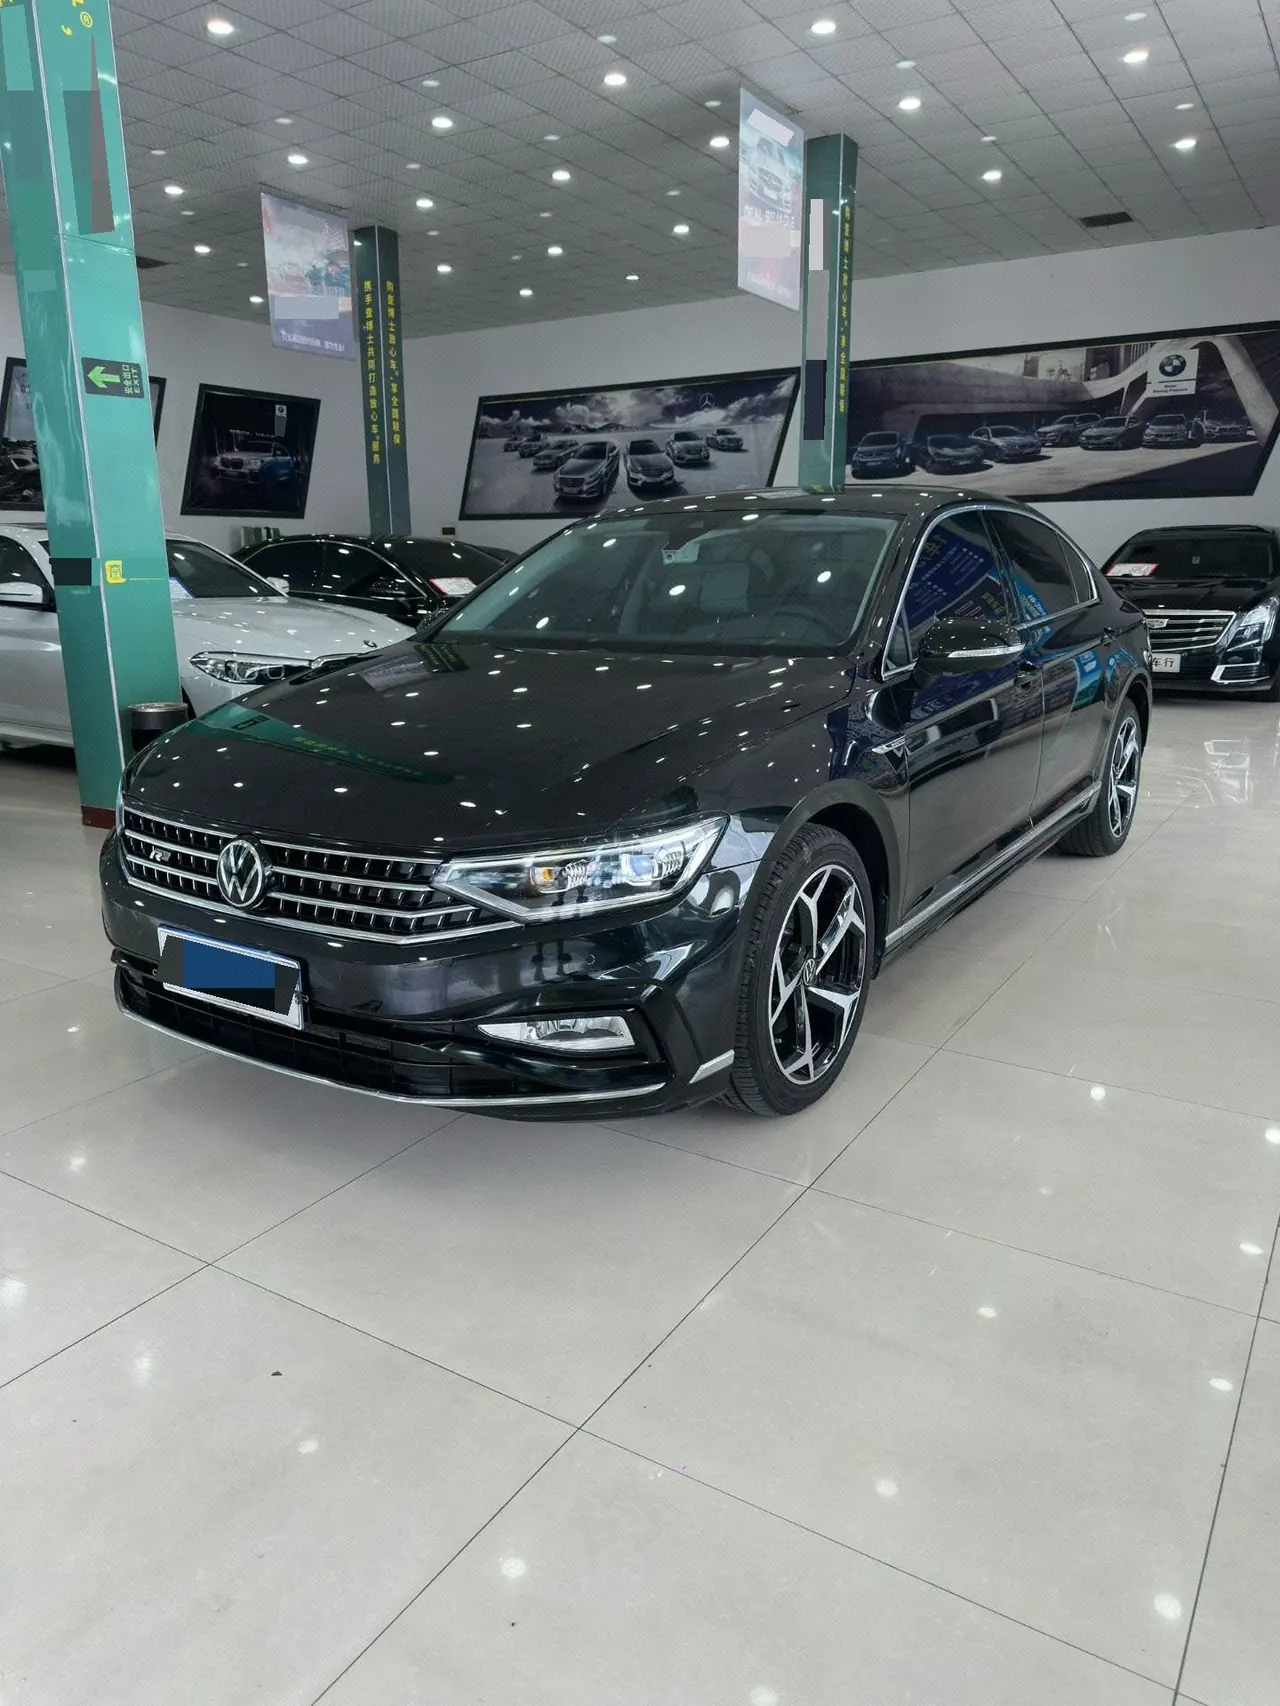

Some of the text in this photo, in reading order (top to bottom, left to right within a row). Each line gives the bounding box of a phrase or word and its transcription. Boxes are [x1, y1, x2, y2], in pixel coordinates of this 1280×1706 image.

[122, 364, 133, 394] 安全出口
[132, 367, 141, 394] EXIT
[1152, 657, 1175, 668] 车行
